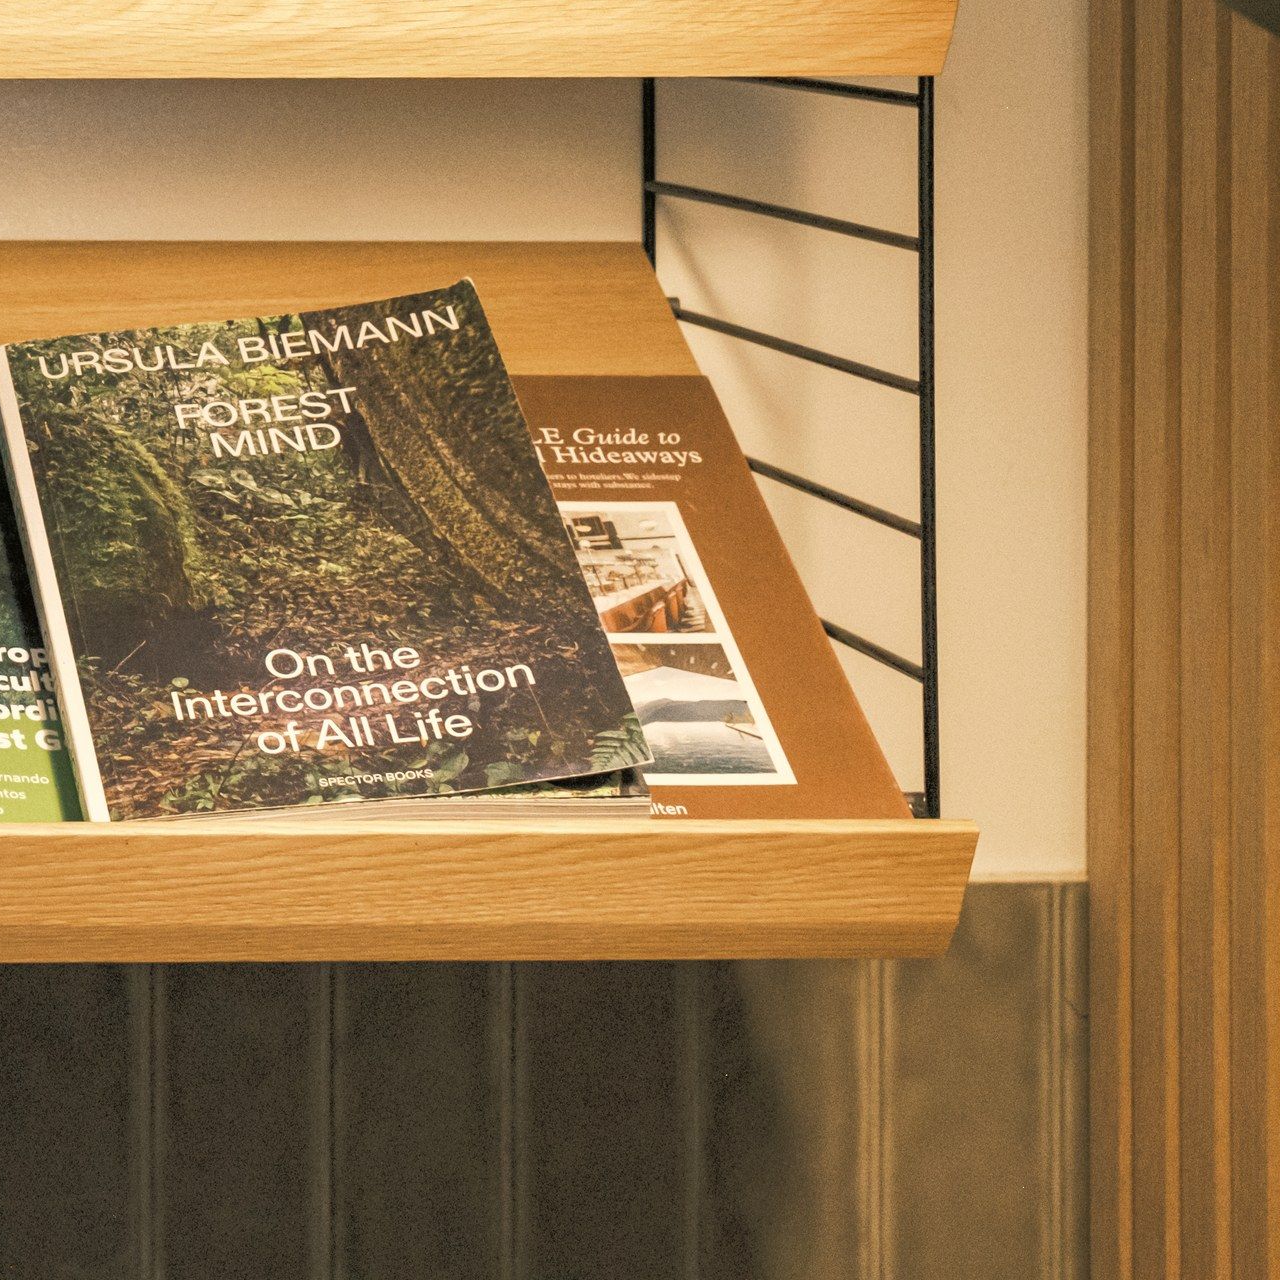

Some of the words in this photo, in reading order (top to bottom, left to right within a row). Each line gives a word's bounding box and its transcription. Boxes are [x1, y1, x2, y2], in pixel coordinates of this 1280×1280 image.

[38, 340, 230, 380] URSULA
[237, 305, 461, 365] BIEMANN
[174, 386, 358, 430] FOREST
[210, 423, 342, 458] MIND
[572, 427, 650, 445] Guide
[657, 432, 681, 445] to
[551, 446, 703, 467] Hideaways
[264, 648, 335, 680] On
[344, 642, 421, 673] the
[170, 663, 537, 721] Interconnection
[257, 721, 301, 756] of
[315, 715, 376, 751] All
[385, 707, 474, 745] Life
[318, 773, 384, 788] SPECTOR
[385, 768, 435, 782] BOOKS
